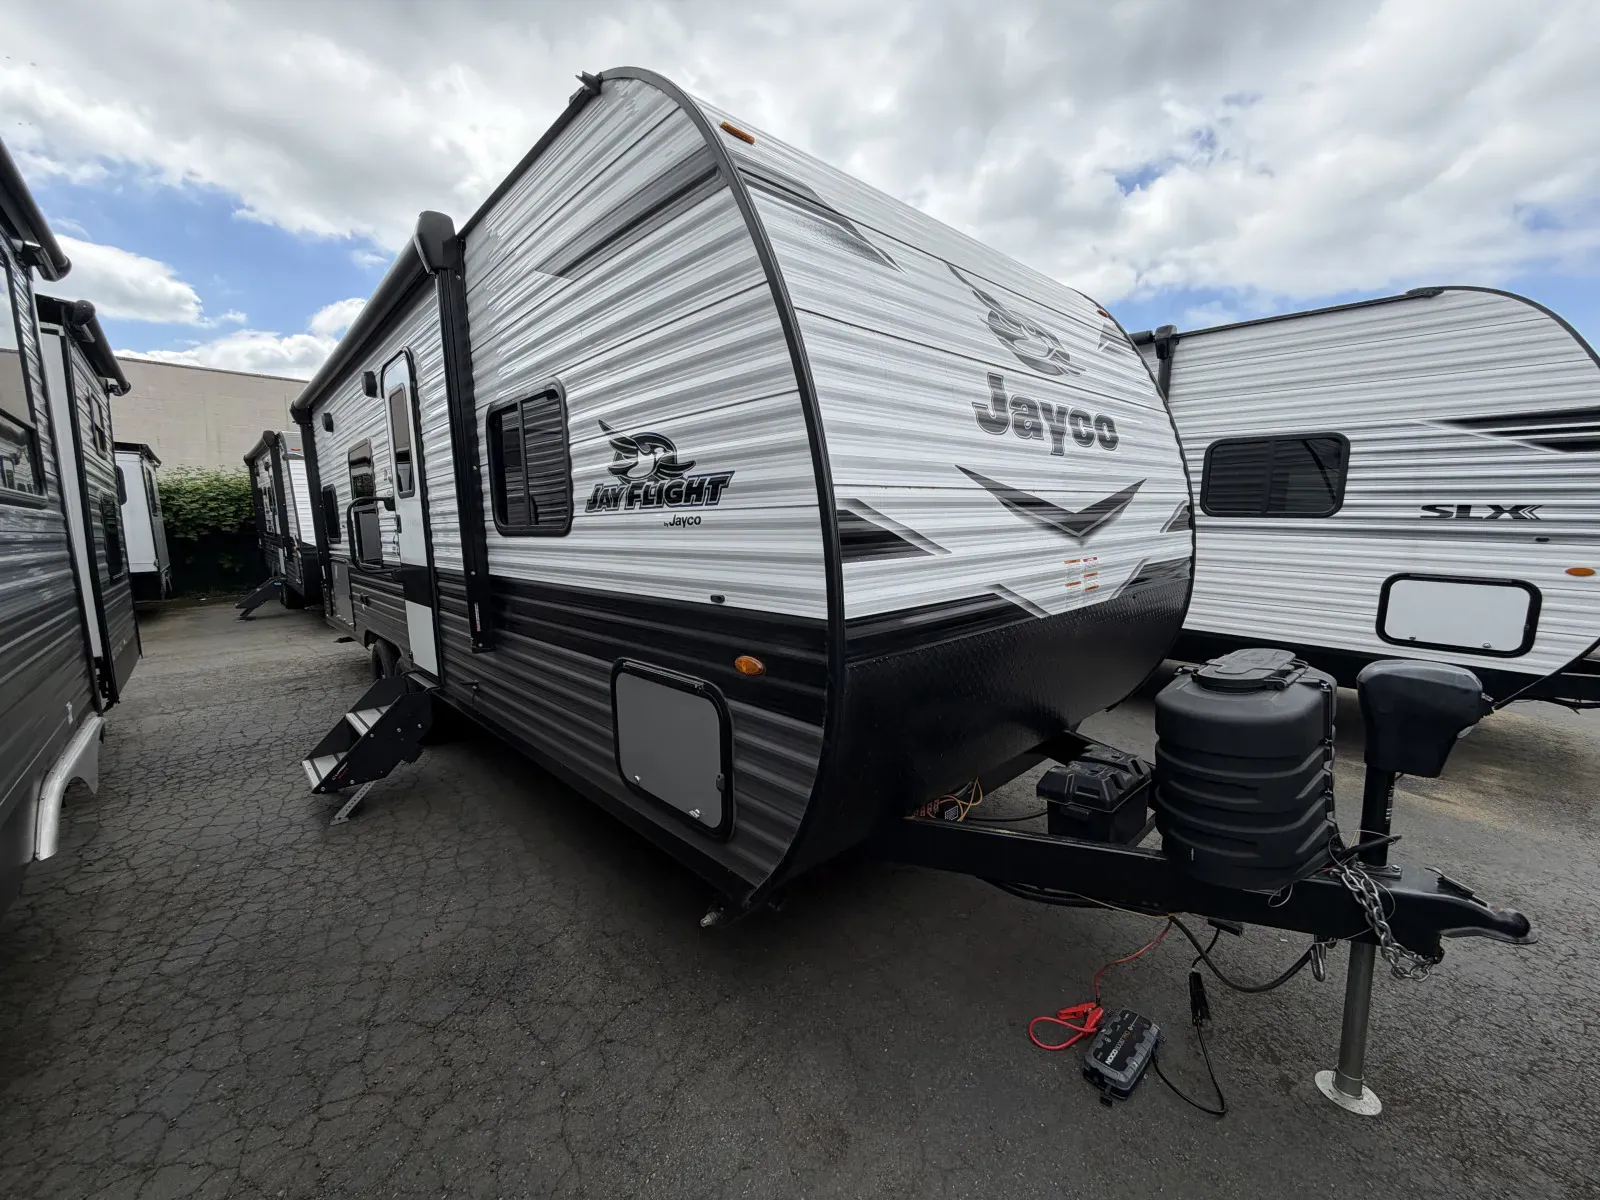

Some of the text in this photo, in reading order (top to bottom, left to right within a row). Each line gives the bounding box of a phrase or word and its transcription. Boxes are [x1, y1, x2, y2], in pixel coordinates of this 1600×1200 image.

[971, 371, 1119, 456] Jayco
[585, 470, 735, 513] JAY FLIGHT
[669, 513, 702, 528] Jayco
[1420, 505, 1543, 520] SLX
[1105, 1048, 1118, 1065] NOCO
